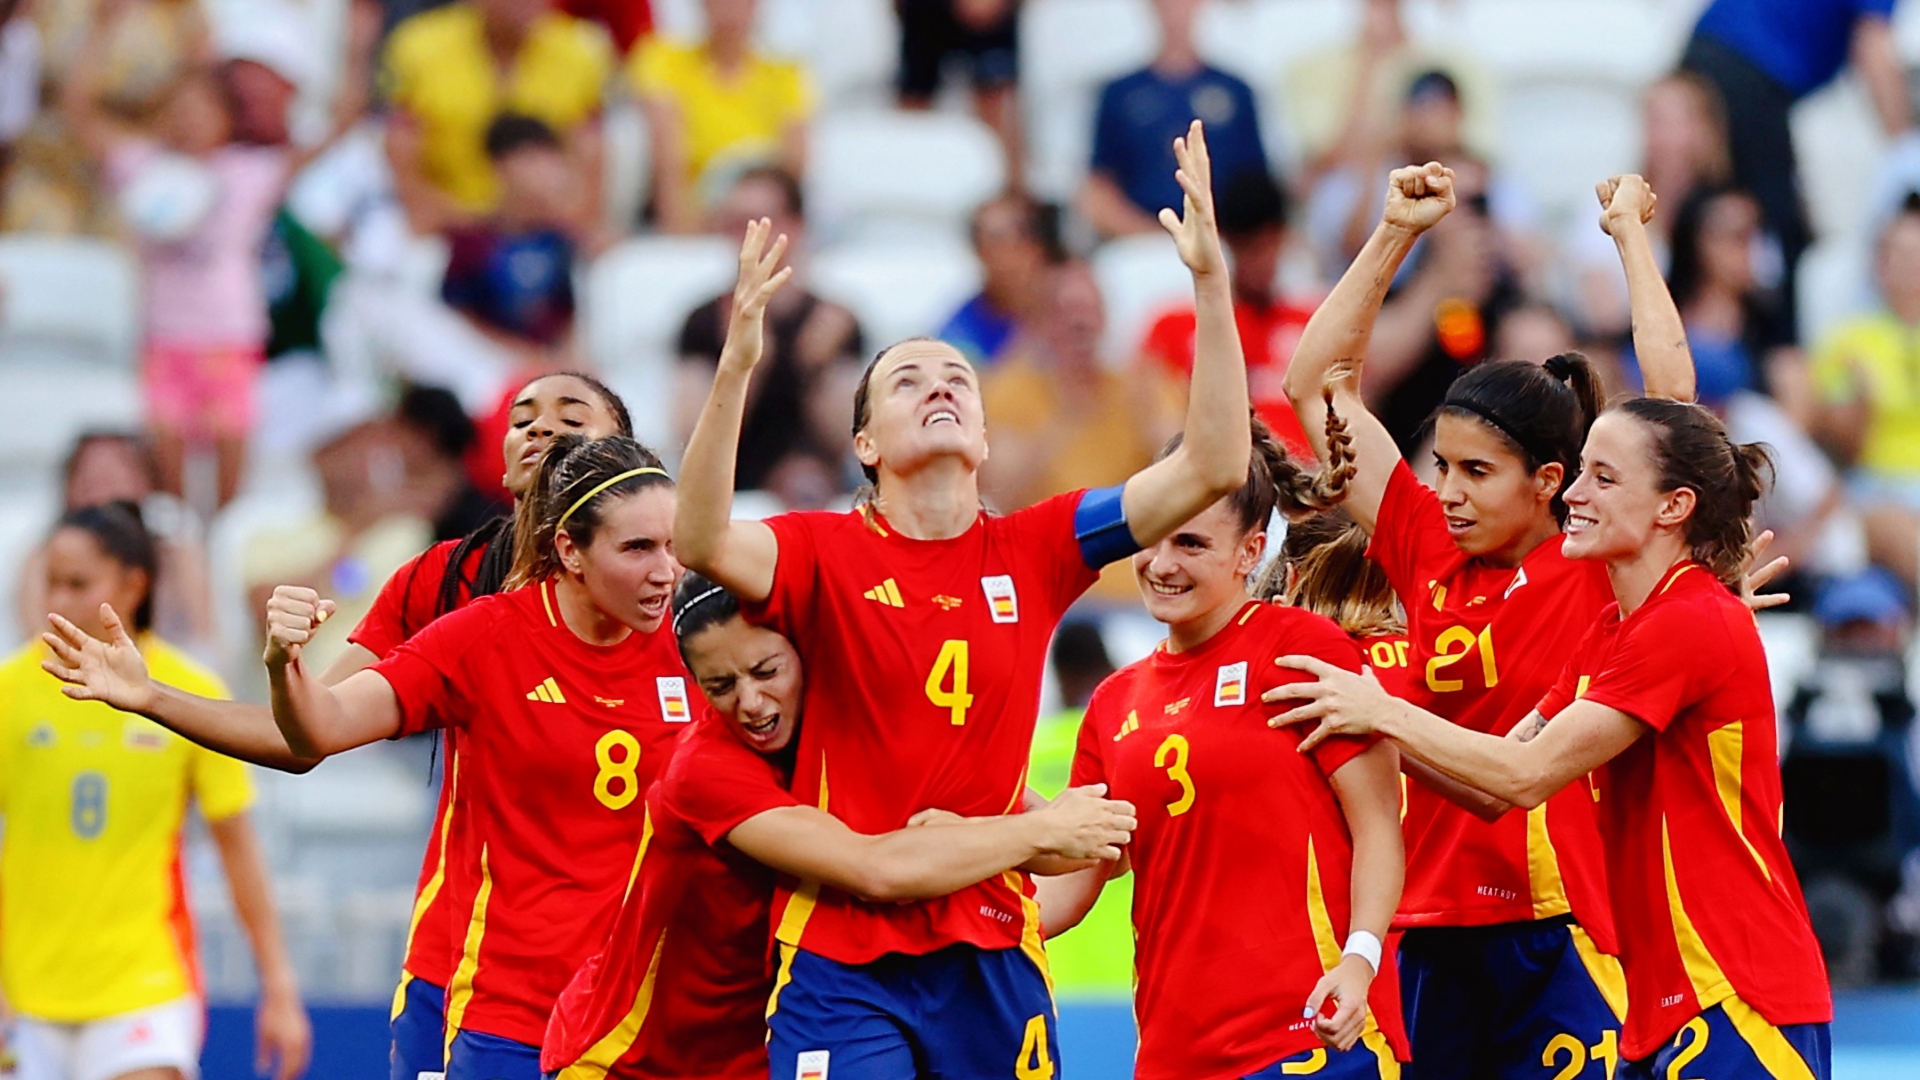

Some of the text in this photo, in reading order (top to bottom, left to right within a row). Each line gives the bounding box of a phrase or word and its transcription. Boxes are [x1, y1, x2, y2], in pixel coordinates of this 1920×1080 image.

[925, 639, 974, 725] 4
[1426, 623, 1498, 692] 21
[69, 767, 110, 842] 8
[593, 730, 641, 810] 8
[1154, 733, 1196, 817] 3
[1015, 1014, 1055, 1080] 4
[1542, 1030, 1619, 1080] 21
[1667, 1016, 1710, 1080] 2
